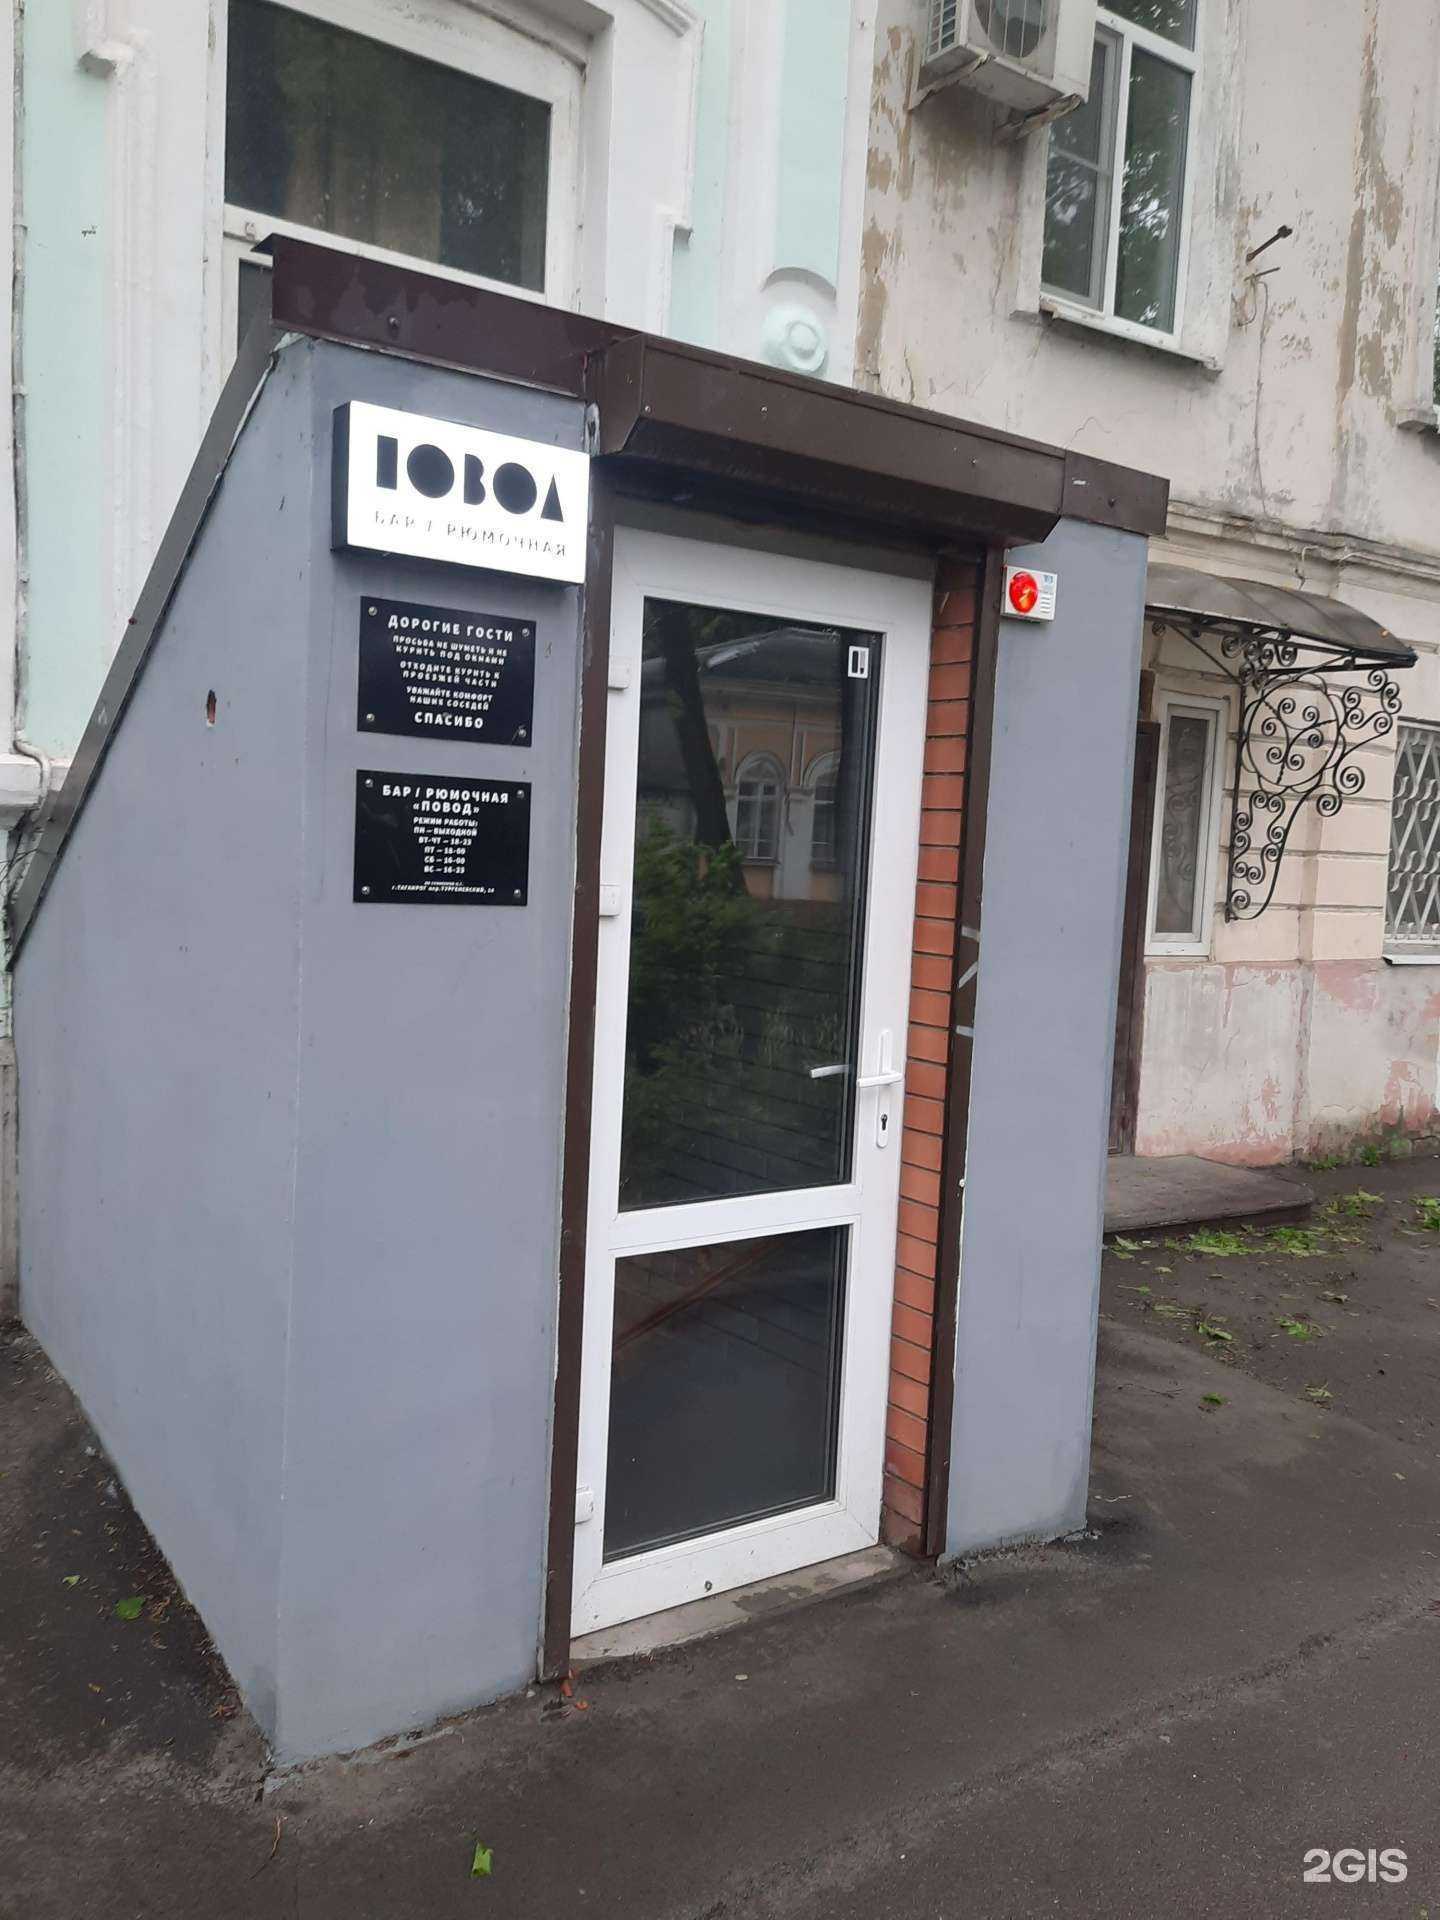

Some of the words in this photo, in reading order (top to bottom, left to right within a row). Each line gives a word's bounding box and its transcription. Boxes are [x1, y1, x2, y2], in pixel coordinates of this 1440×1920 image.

[447, 522, 566, 557] РЮМОЧНАЯ
[388, 614, 461, 636] ДОРОГИЕ
[467, 625, 514, 642] ГОСТИ
[393, 634, 435, 648] ПРОСЬБА
[436, 640, 448, 650] НЕ
[450, 642, 486, 655] ШУМЕТЬ
[488, 646, 495, 655] И
[496, 648, 507, 657] НЕ
[395, 644, 436, 657] КУРИТЬ
[440, 649, 461, 661] ПОД
[464, 653, 505, 666] ОКНАМИ
[400, 660, 451, 674] ОТХОДИТЕ
[454, 667, 491, 679] КУРИТЬ
[493, 671, 500, 680] К
[402, 670, 460, 684] ПРОЕЗЖЕЙ
[464, 677, 498, 688] ЧАСТИ
[406, 685, 451, 698] УВАЖАЙТЕ
[453, 691, 493, 702] КОМФОРТ
[446, 699, 489, 711] СОСЕДЕЙ
[414, 711, 485, 729] СПАСИБО
[382, 784, 412, 798] БАР
[426, 788, 510, 804] РЮМОЧНАЯ
[412, 800, 480, 816] «ПОВОД»
[413, 816, 442, 826] РЕЖИМ
[443, 818, 479, 827] РАБОТЫ:
[413, 826, 426, 834] ПН
[433, 827, 478, 837] ВЫХОДНОЙ
[418, 836, 441, 845] ВТ-ЧТ
[424, 845, 435, 854] ПТ
[424, 865, 434, 873] ВС
